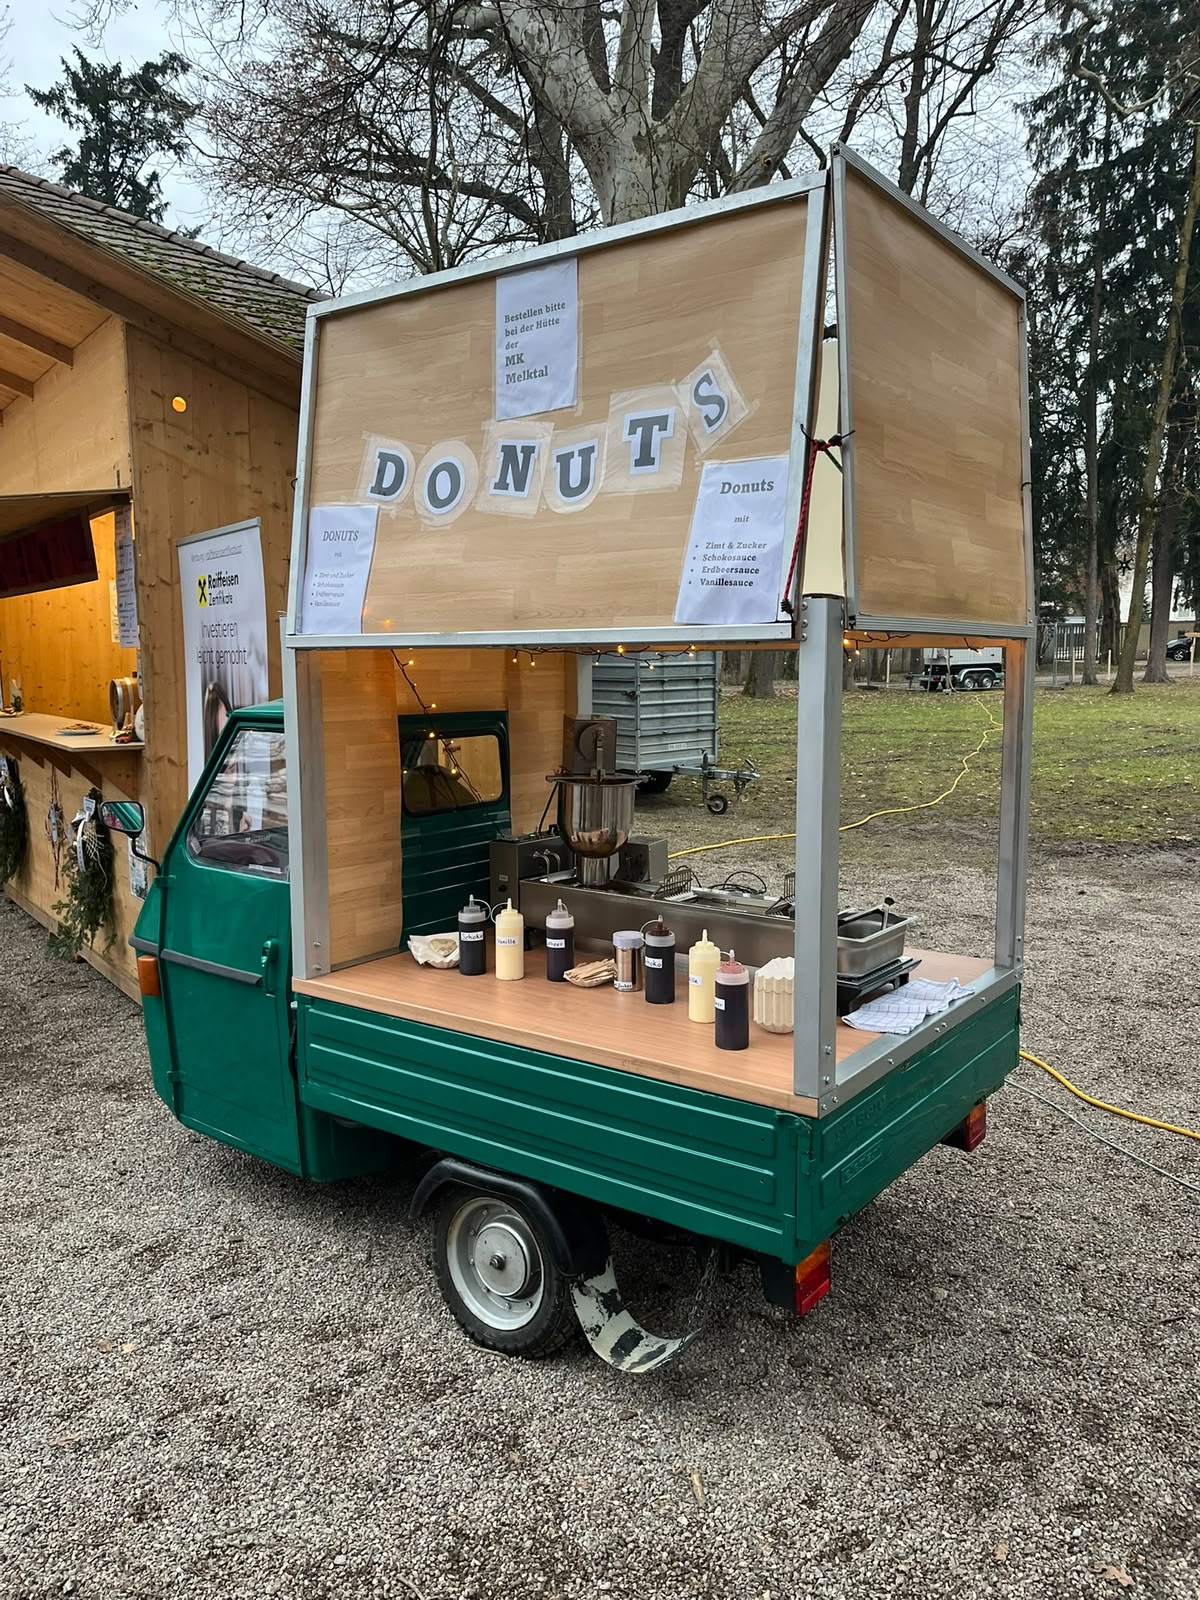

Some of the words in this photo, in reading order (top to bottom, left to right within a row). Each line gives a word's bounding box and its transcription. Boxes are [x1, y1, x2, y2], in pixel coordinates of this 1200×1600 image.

[504, 308, 543, 323] Bestellen
[545, 302, 566, 313] bitte
[505, 326, 518, 337] bei
[520, 324, 534, 333] der
[536, 317, 560, 330] Hütte
[505, 341, 519, 350] der
[505, 353, 525, 367] MK
[505, 365, 549, 385] Melktal
[370, 373, 726, 509] DONUTS
[720, 479, 774, 494] Donuts
[734, 515, 749, 523] mit
[323, 530, 359, 541] DONUTS
[705, 542, 725, 550] Zimt
[727, 542, 735, 550] &
[736, 542, 767, 550] Zucker
[702, 553, 757, 562] Schokosauce
[702, 566, 760, 575] Erdbeersauce
[208, 570, 239, 589] Raiffeisen
[700, 578, 754, 587] Vanillesauce
[201, 619, 239, 638] Investieren
[197, 646, 215, 665] leicht
[215, 645, 247, 669] gemacht
